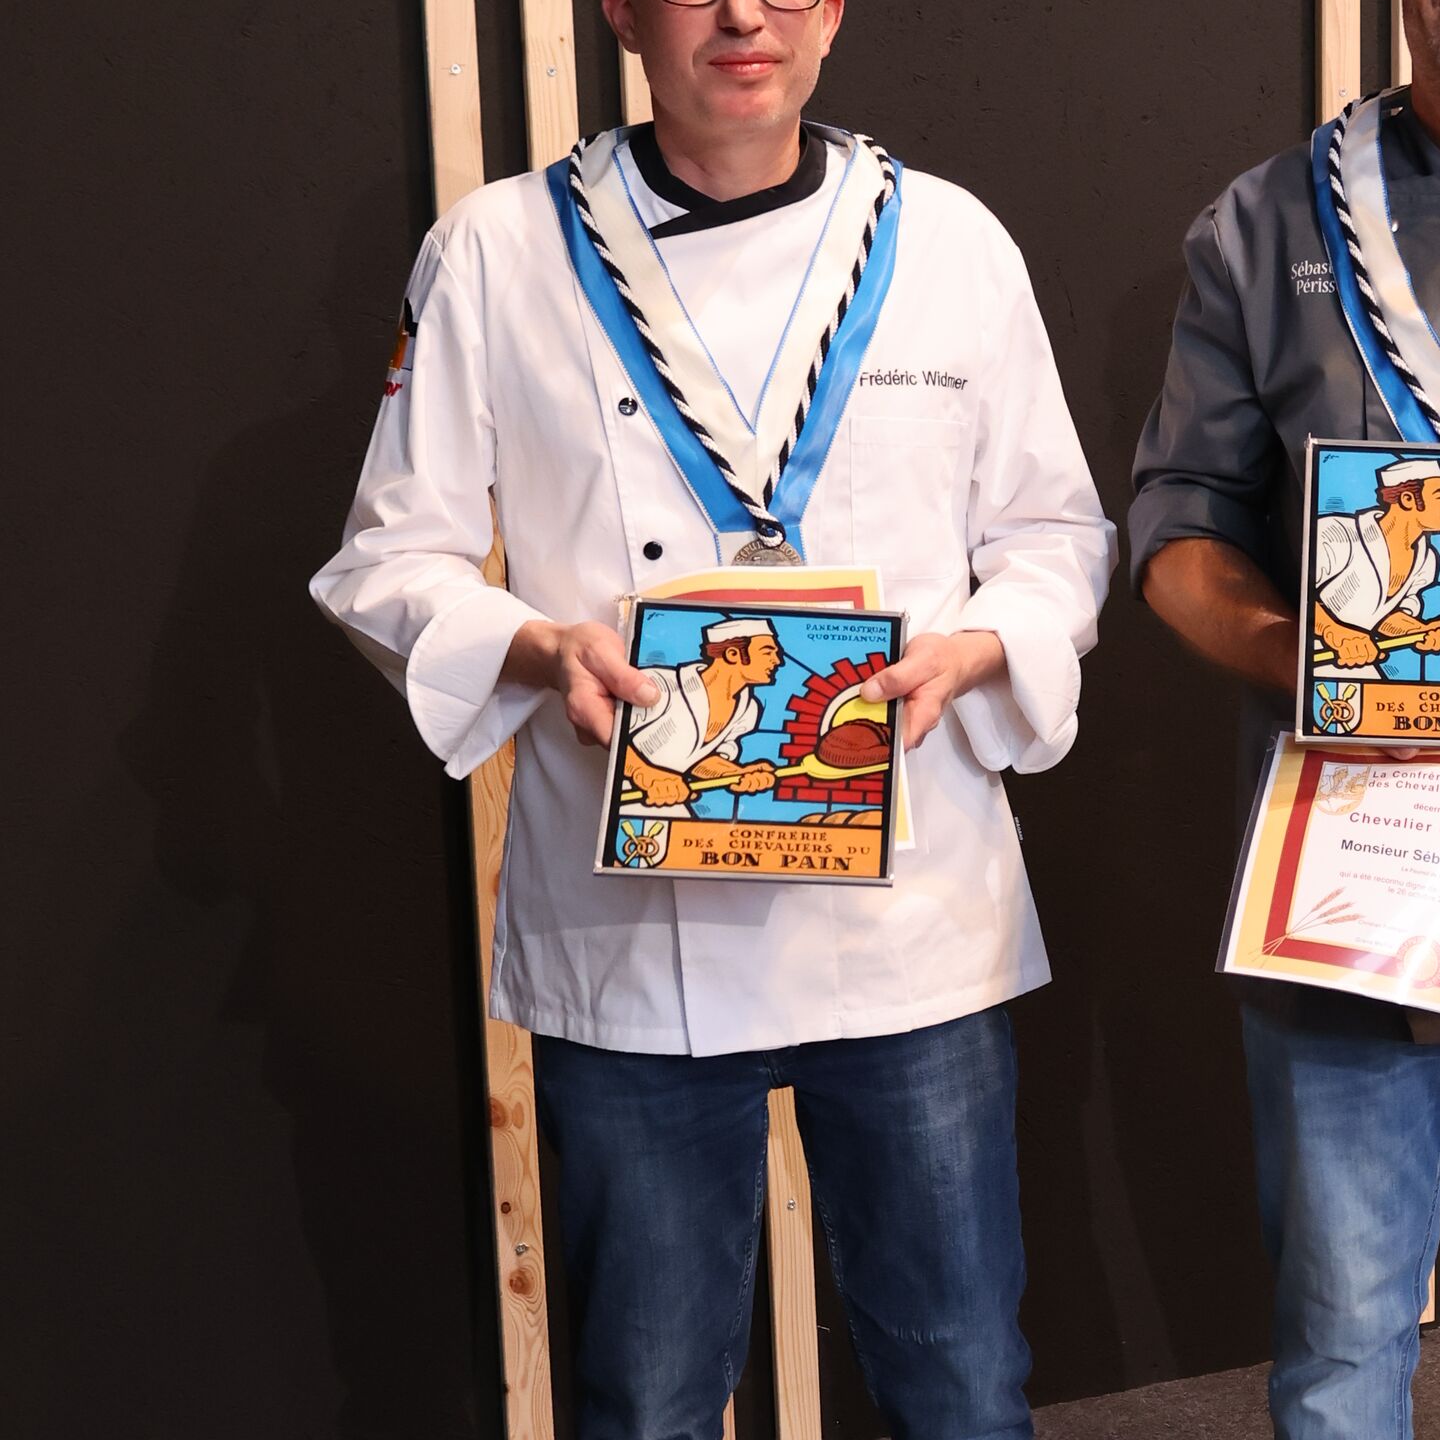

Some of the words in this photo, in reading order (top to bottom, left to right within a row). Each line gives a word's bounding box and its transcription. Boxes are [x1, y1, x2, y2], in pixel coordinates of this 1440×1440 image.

[859, 369, 917, 386] Frédéric
[922, 371, 968, 390] Widmer
[806, 623, 839, 631] PANEM
[843, 625, 887, 634] NOSTRUM
[807, 633, 887, 643] QUOTIDIANUM
[1376, 702, 1405, 712] DES
[1368, 780, 1390, 788] des
[1349, 812, 1433, 833] Chevalier
[729, 829, 827, 841] CONFRERIE
[683, 839, 714, 848] DES
[729, 839, 833, 853] CHEVALIERS
[847, 846, 871, 855] DU
[1340, 839, 1409, 859] Monsieur
[699, 851, 763, 867] BON
[779, 854, 853, 870] PAIN
